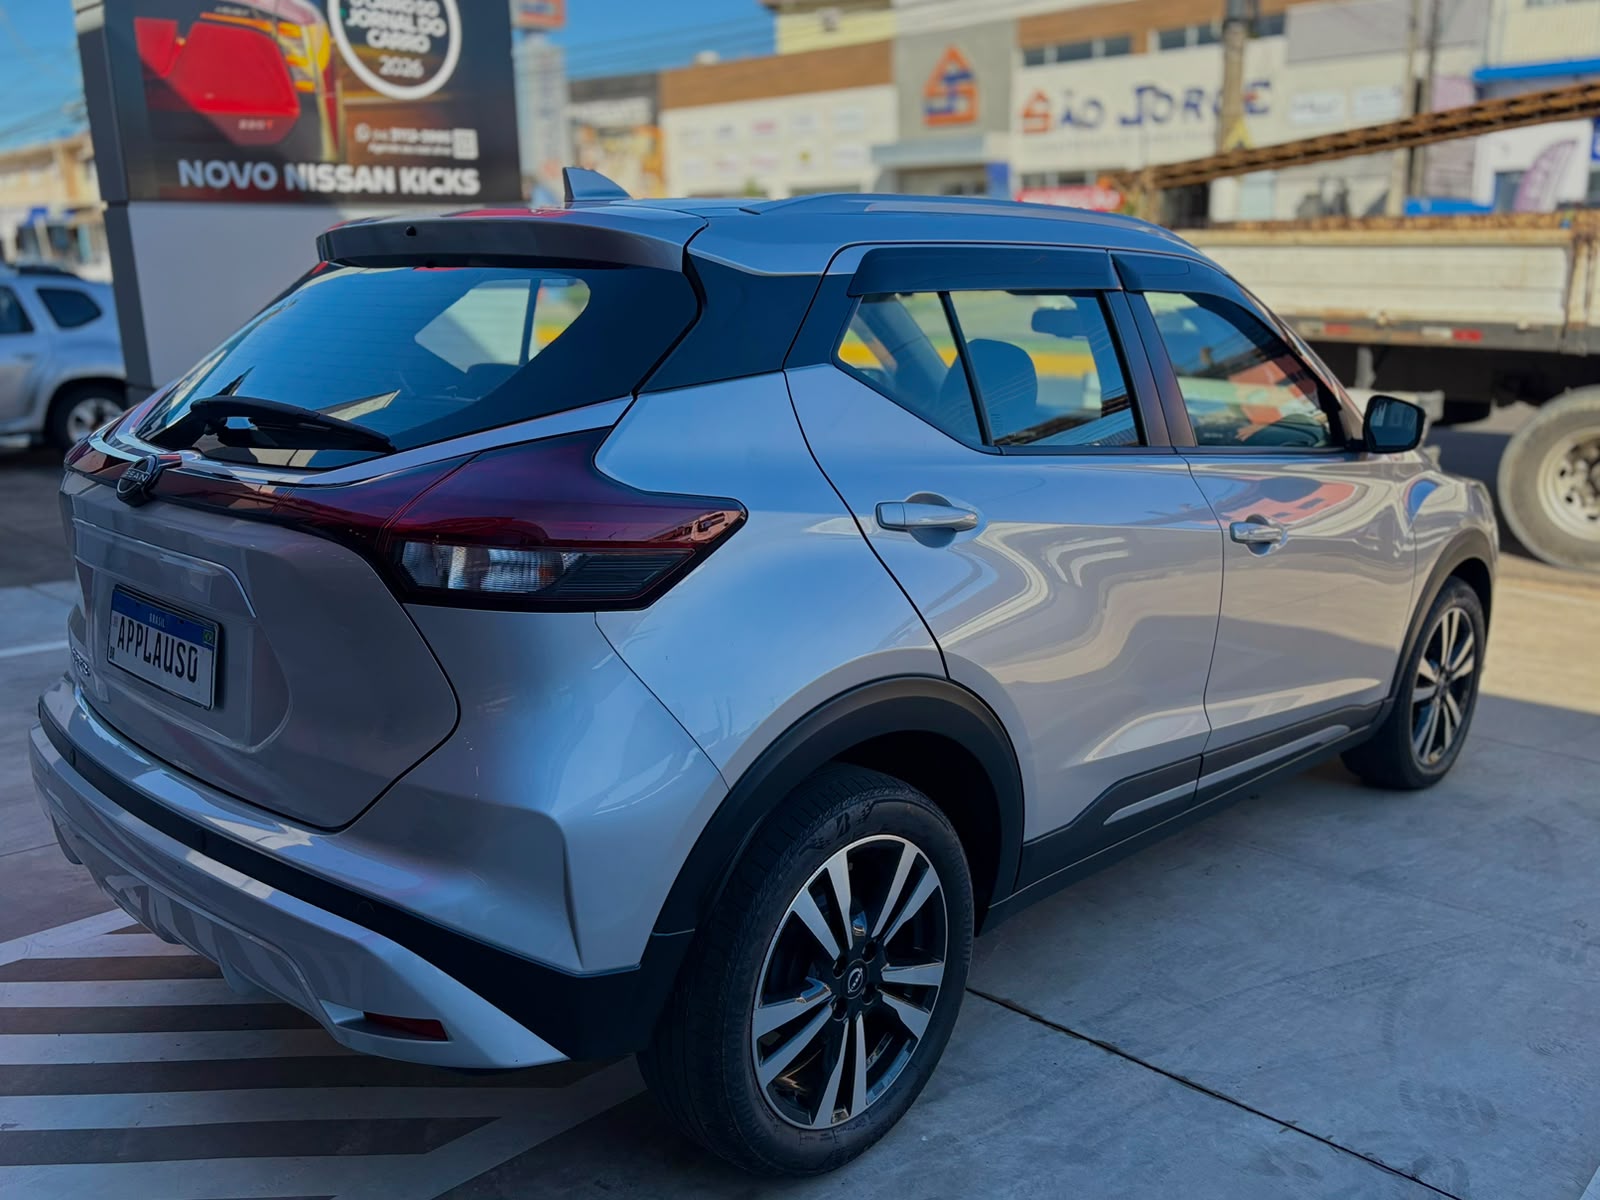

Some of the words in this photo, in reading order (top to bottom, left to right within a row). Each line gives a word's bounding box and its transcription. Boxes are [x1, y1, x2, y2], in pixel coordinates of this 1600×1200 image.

[346, 8, 417, 34] JORNAL
[418, 17, 446, 37] DO
[366, 28, 431, 53] CARRO
[1119, 80, 1271, 127] JORE
[178, 159, 278, 190] NOVO
[284, 163, 397, 194] NISSAN
[399, 166, 481, 196] KICKS
[149, 613, 165, 628] BRASIL
[117, 616, 199, 684] APPLAUSO
